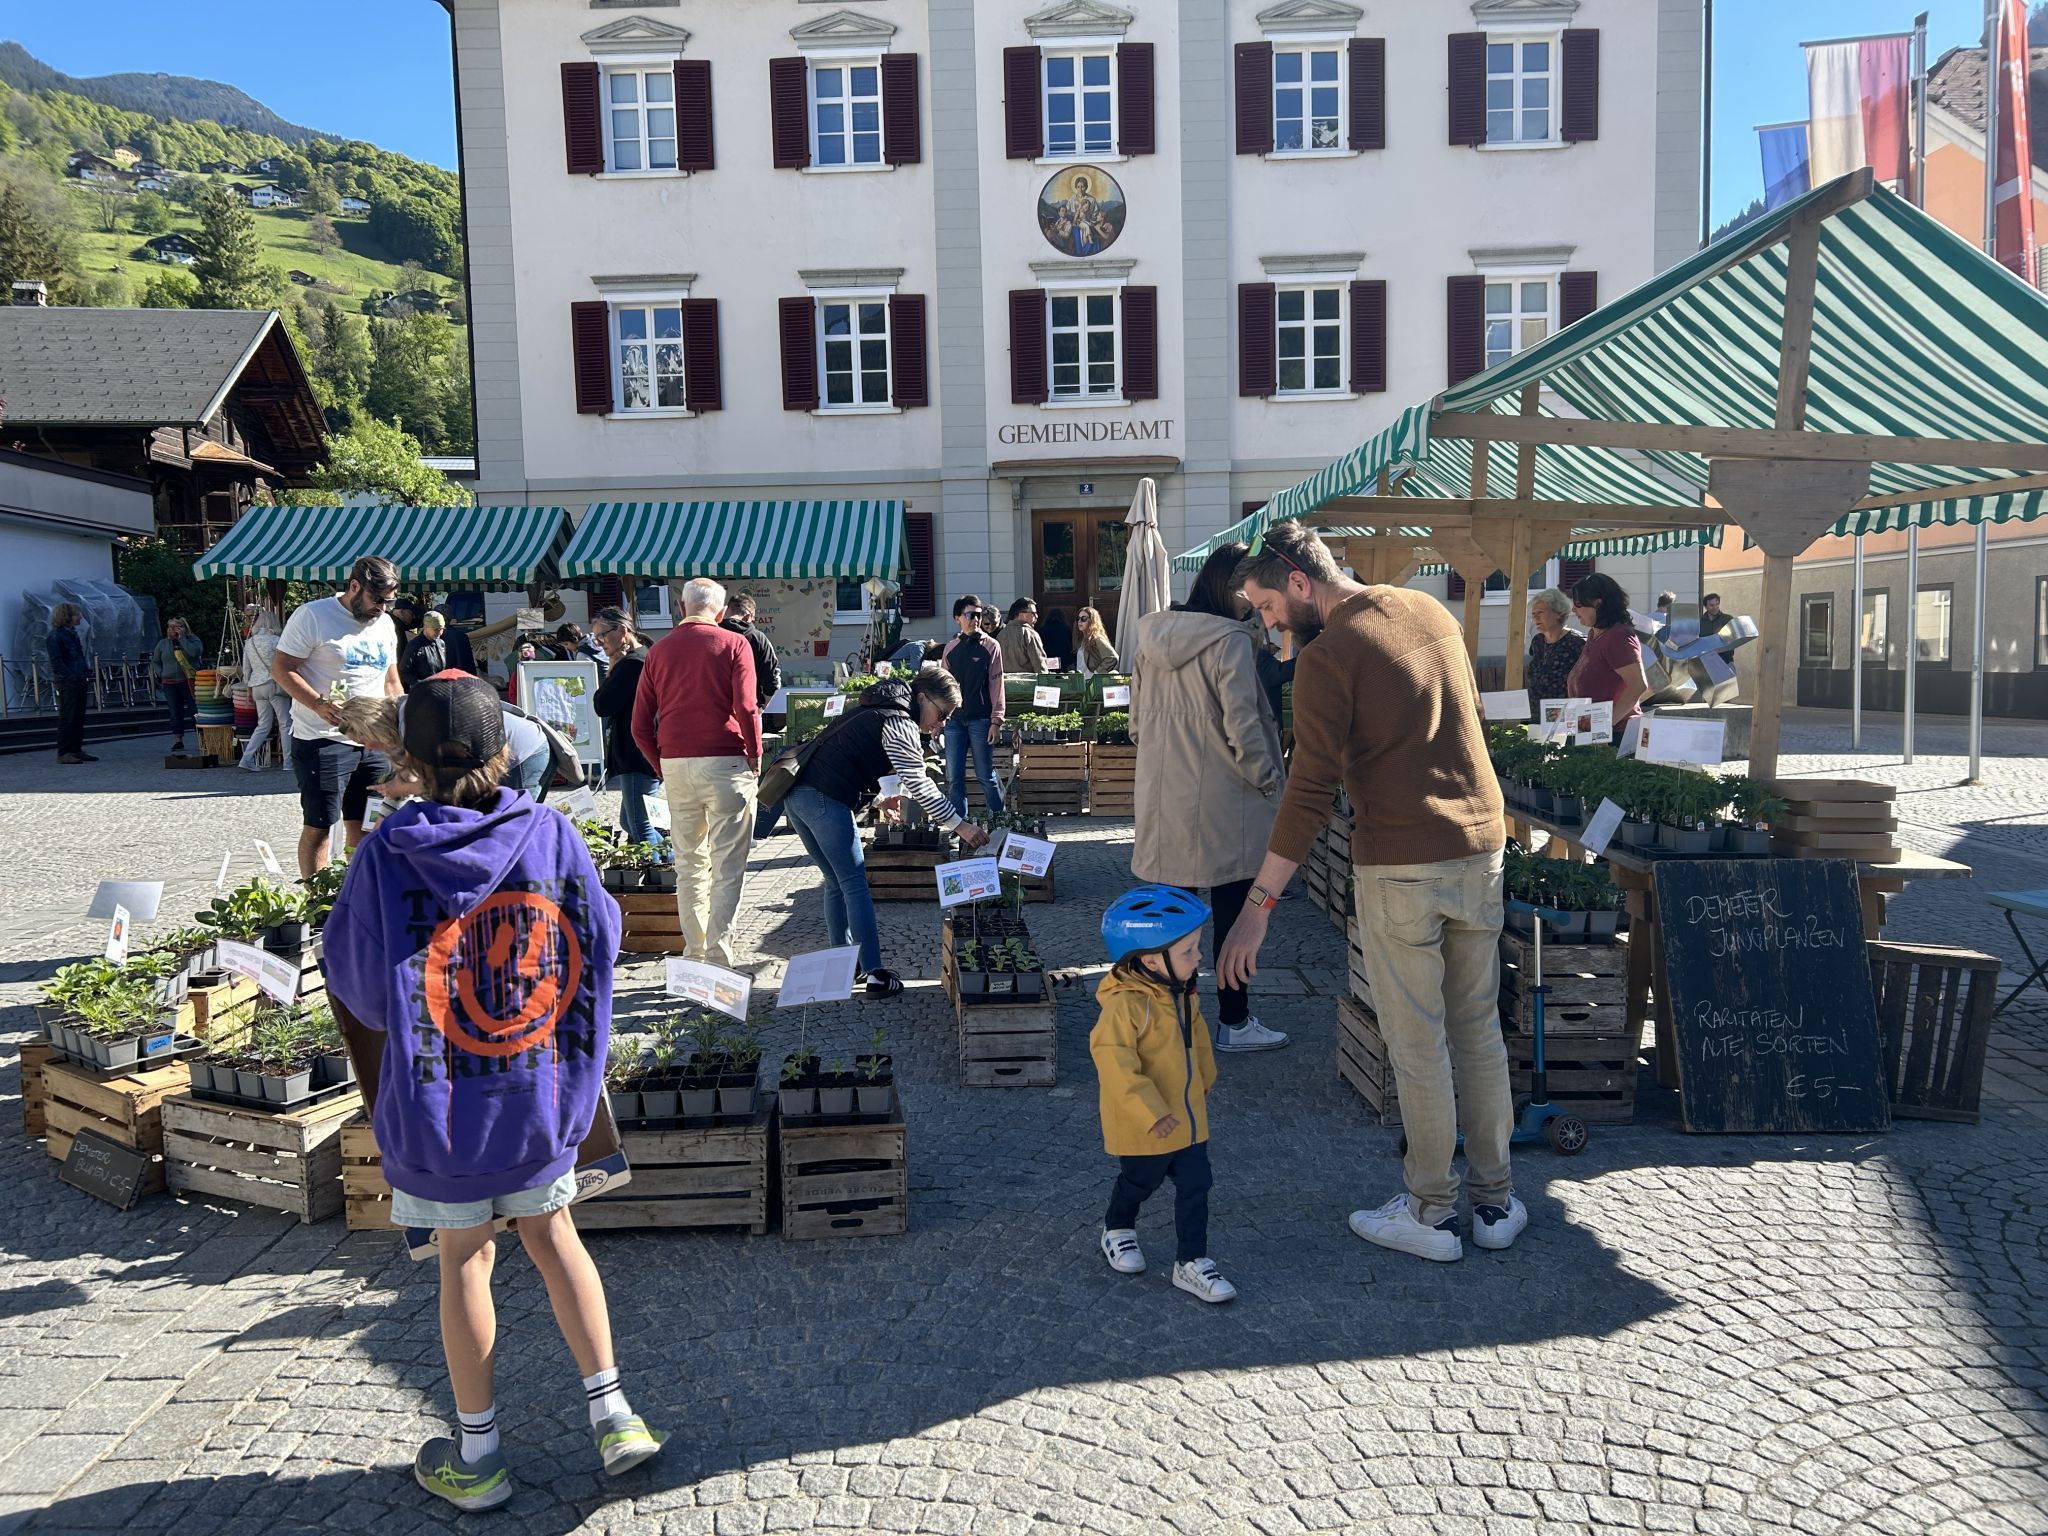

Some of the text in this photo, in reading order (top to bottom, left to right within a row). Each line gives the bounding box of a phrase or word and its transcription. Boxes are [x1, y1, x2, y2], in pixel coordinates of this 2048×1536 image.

[998, 420, 1174, 444] GEMEINDEAMT
[753, 616, 774, 624] FALT
[1684, 887, 1794, 924] DEMETER
[1701, 1034, 1745, 1062] ALTE
[1755, 1027, 1850, 1056] SORTEN
